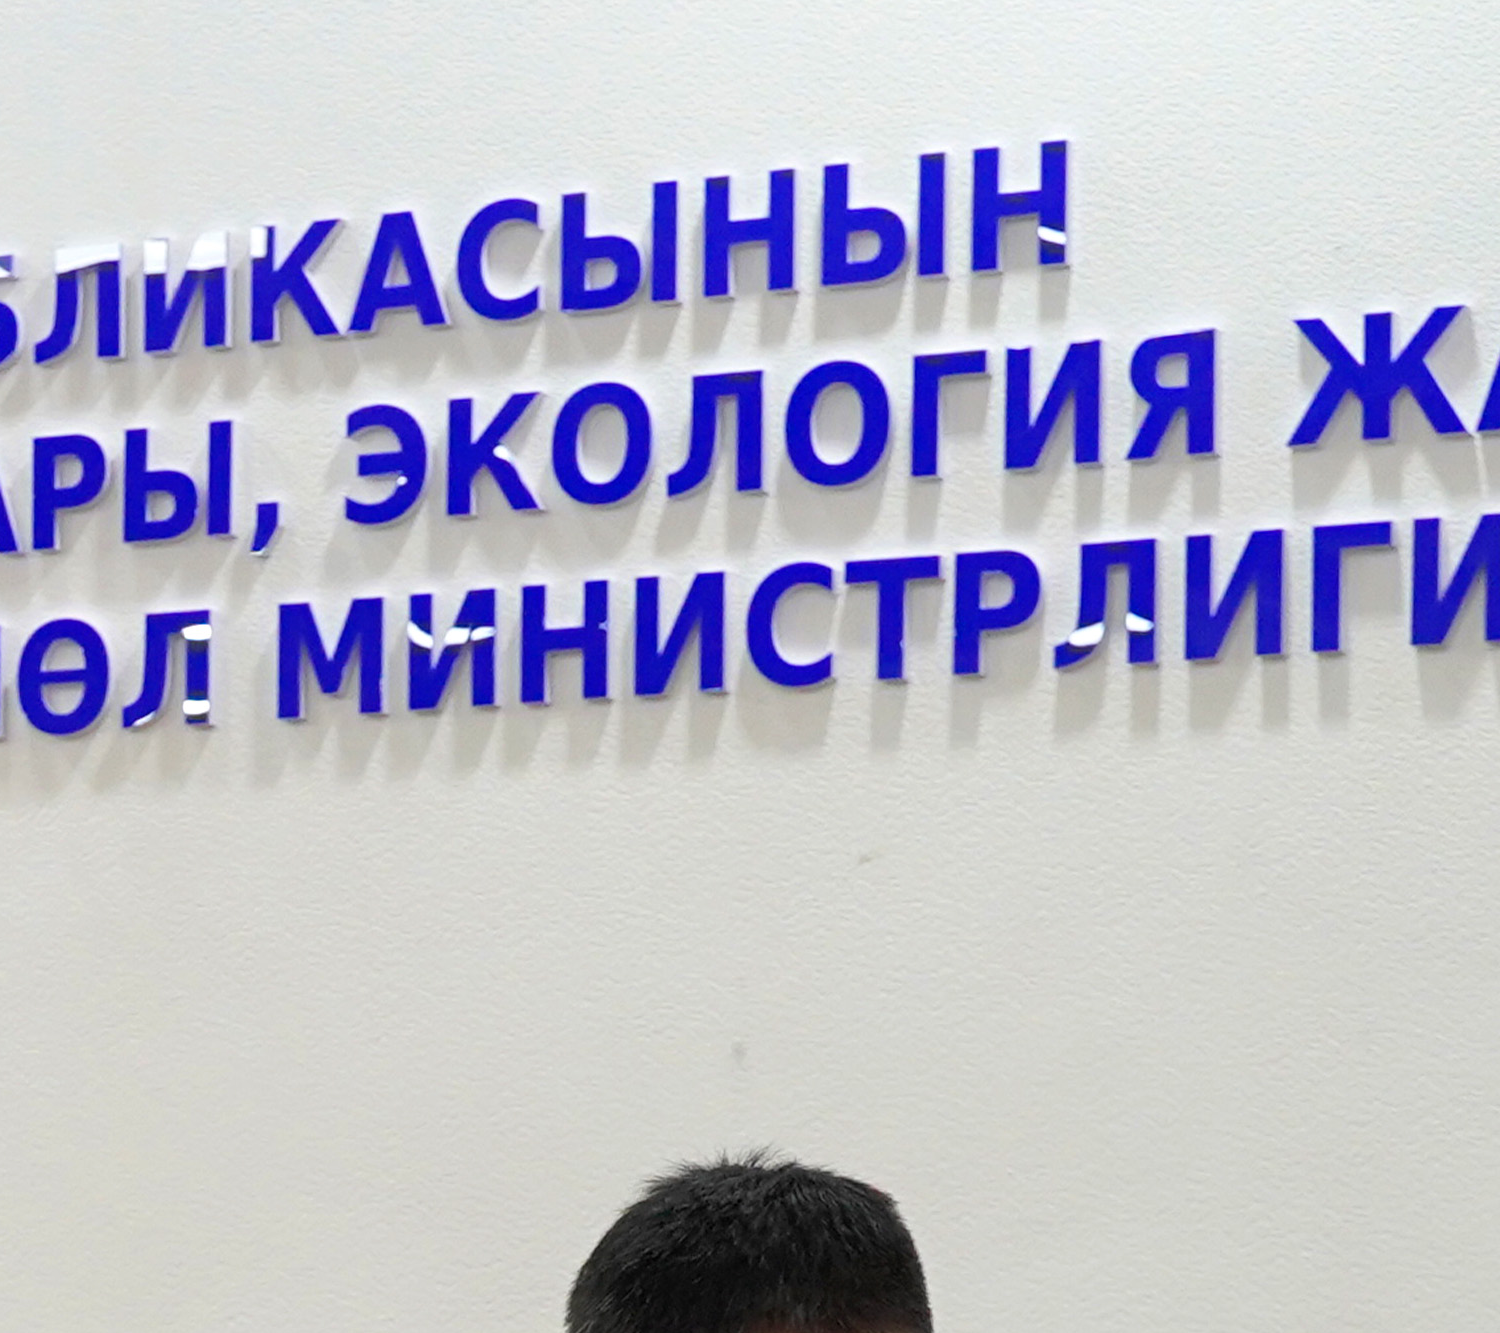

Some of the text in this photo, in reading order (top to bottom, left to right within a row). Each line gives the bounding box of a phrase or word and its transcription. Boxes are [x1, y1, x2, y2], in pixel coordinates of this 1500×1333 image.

[344, 329, 1217, 526] ЭКОЛОГИЯ
[1287, 304, 1500, 447] Ж
[277, 512, 1500, 720] МИНИСТРЛИГИ
